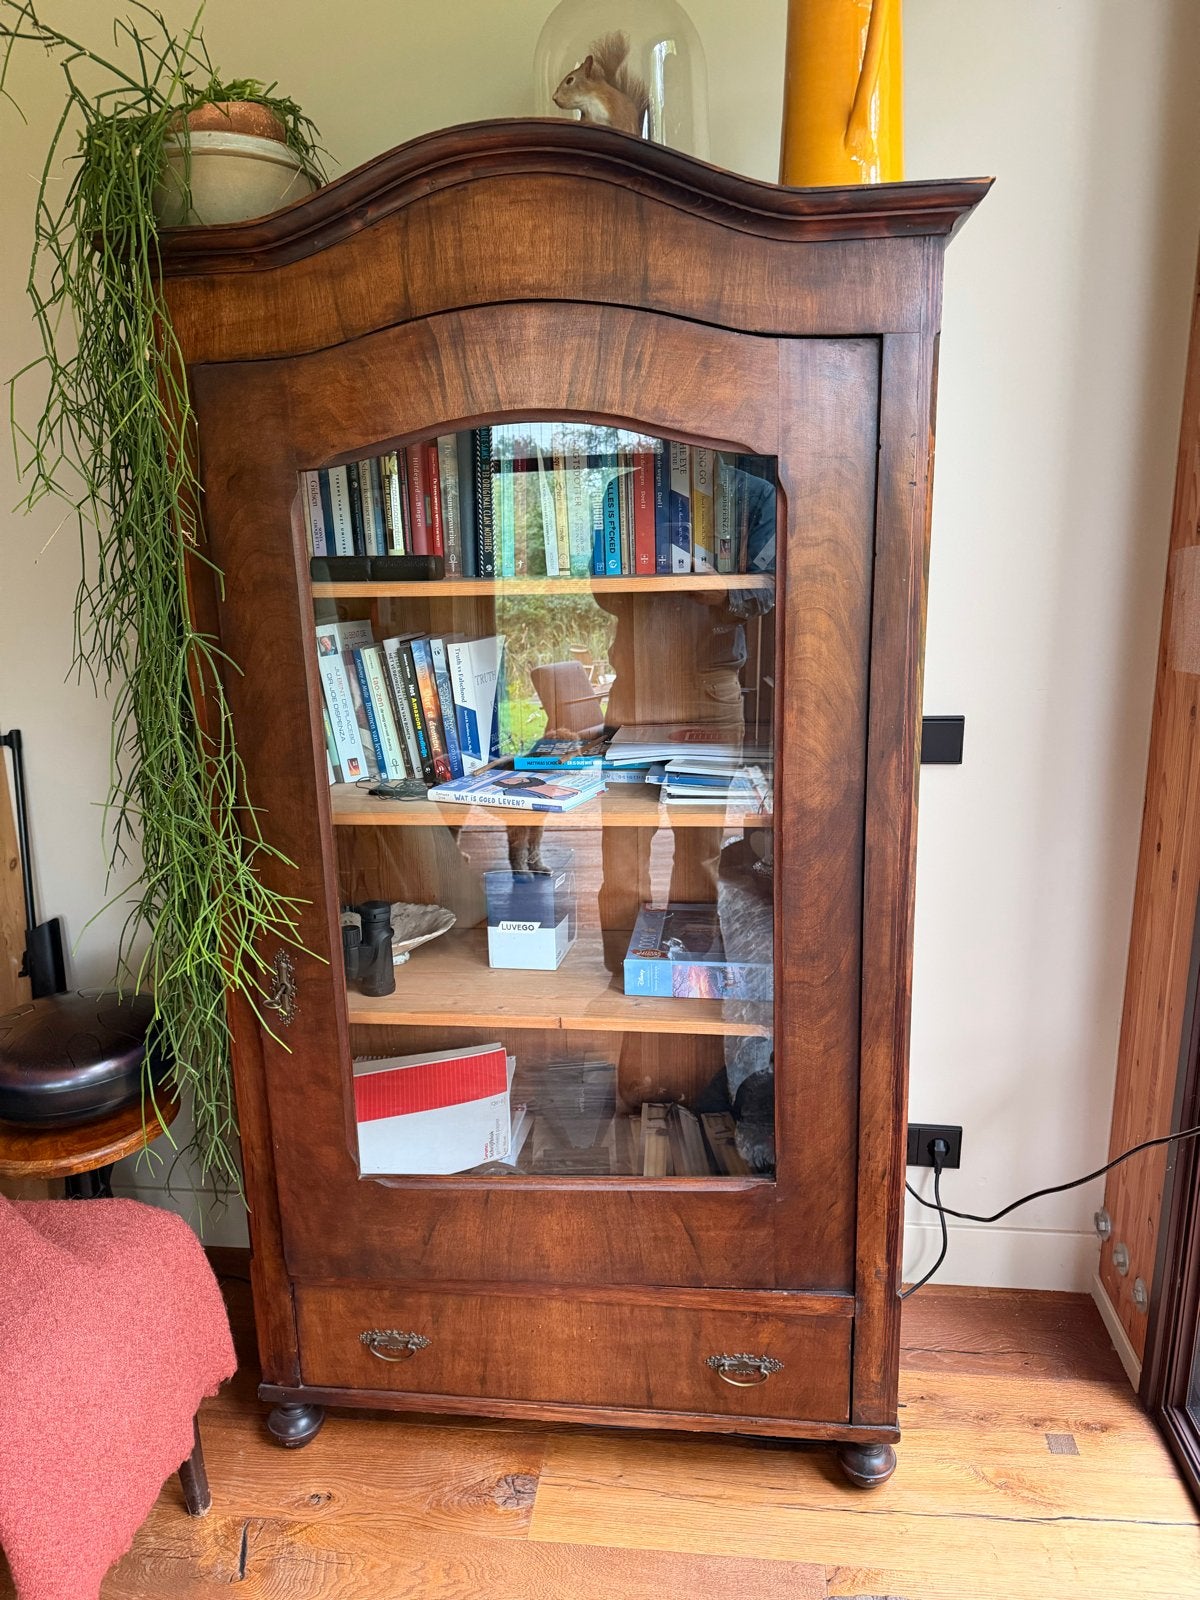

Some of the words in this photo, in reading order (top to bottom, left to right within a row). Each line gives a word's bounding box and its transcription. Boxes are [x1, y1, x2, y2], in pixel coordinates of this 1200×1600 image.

[482, 443, 491, 459] SAMS
[680, 458, 688, 475] EYE
[699, 469, 706, 485] GO
[310, 480, 319, 507] Gidsen
[482, 479, 491, 508] ORIGINAL
[483, 510, 492, 526] CLAN
[608, 510, 615, 519] IS
[484, 527, 493, 553] MOTHERS
[454, 648, 463, 665] Truth
[474, 670, 496, 686] TRUTH
[336, 677, 346, 697] BENT
[458, 673, 467, 703] Falsehood
[341, 698, 348, 709] DE
[390, 663, 401, 694] VERBORGEN
[403, 722, 411, 740] BOMEN
[329, 686, 337, 702] JOE
[333, 703, 346, 742] DISPENZA
[365, 702, 376, 729] Bronnen
[343, 710, 356, 744] PLACEBO
[411, 697, 422, 730] Amazone
[417, 731, 428, 758] medicijn
[371, 730, 379, 742] van
[374, 743, 383, 760] leven
[454, 793, 468, 801] WAT
[479, 796, 496, 804] GOED
[498, 797, 525, 806] LEVEN?
[501, 923, 535, 931] LUVEGO
